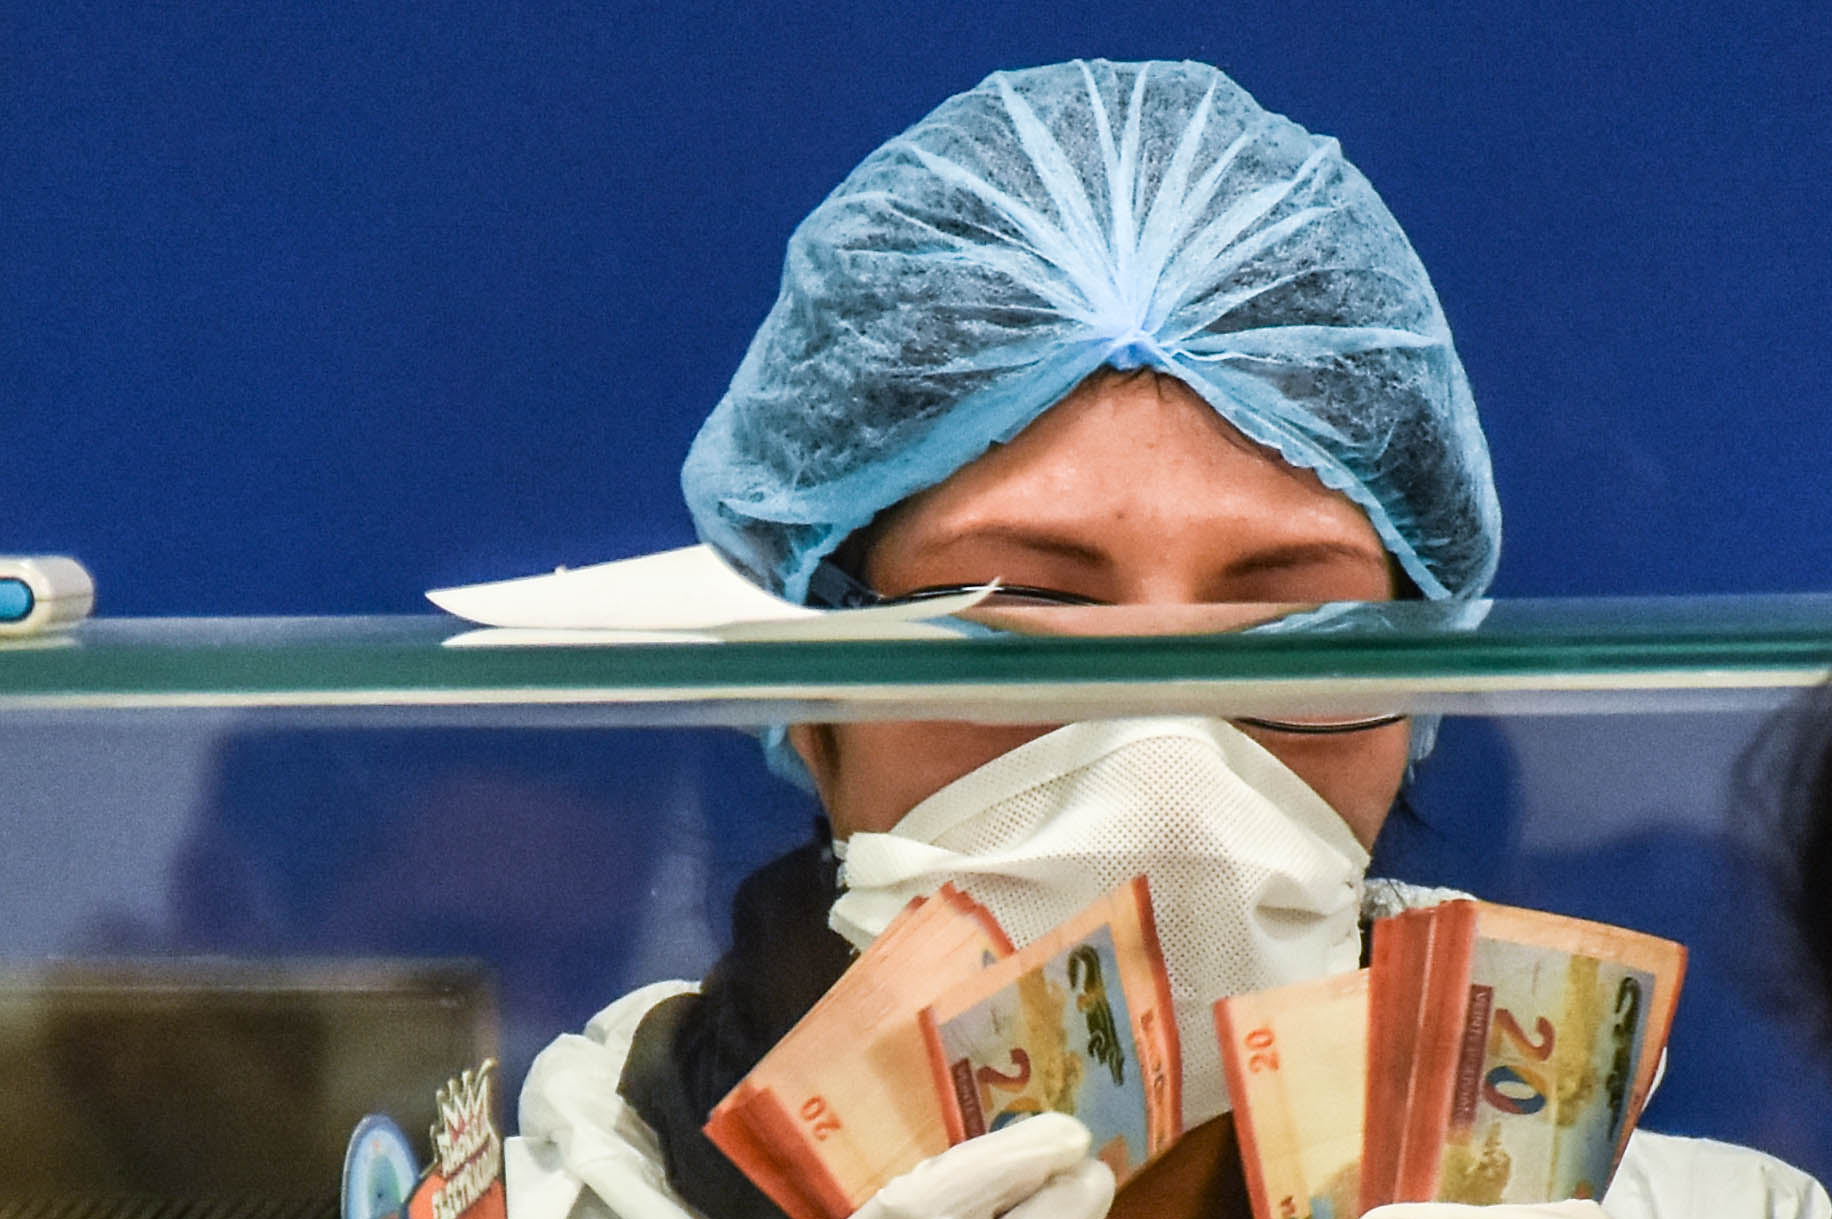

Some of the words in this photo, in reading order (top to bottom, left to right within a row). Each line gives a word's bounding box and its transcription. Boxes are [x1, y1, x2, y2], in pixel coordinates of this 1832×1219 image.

[1244, 1027, 1280, 1074] 20
[1483, 1008, 1556, 1116] 20
[801, 1095, 843, 1142] 20
